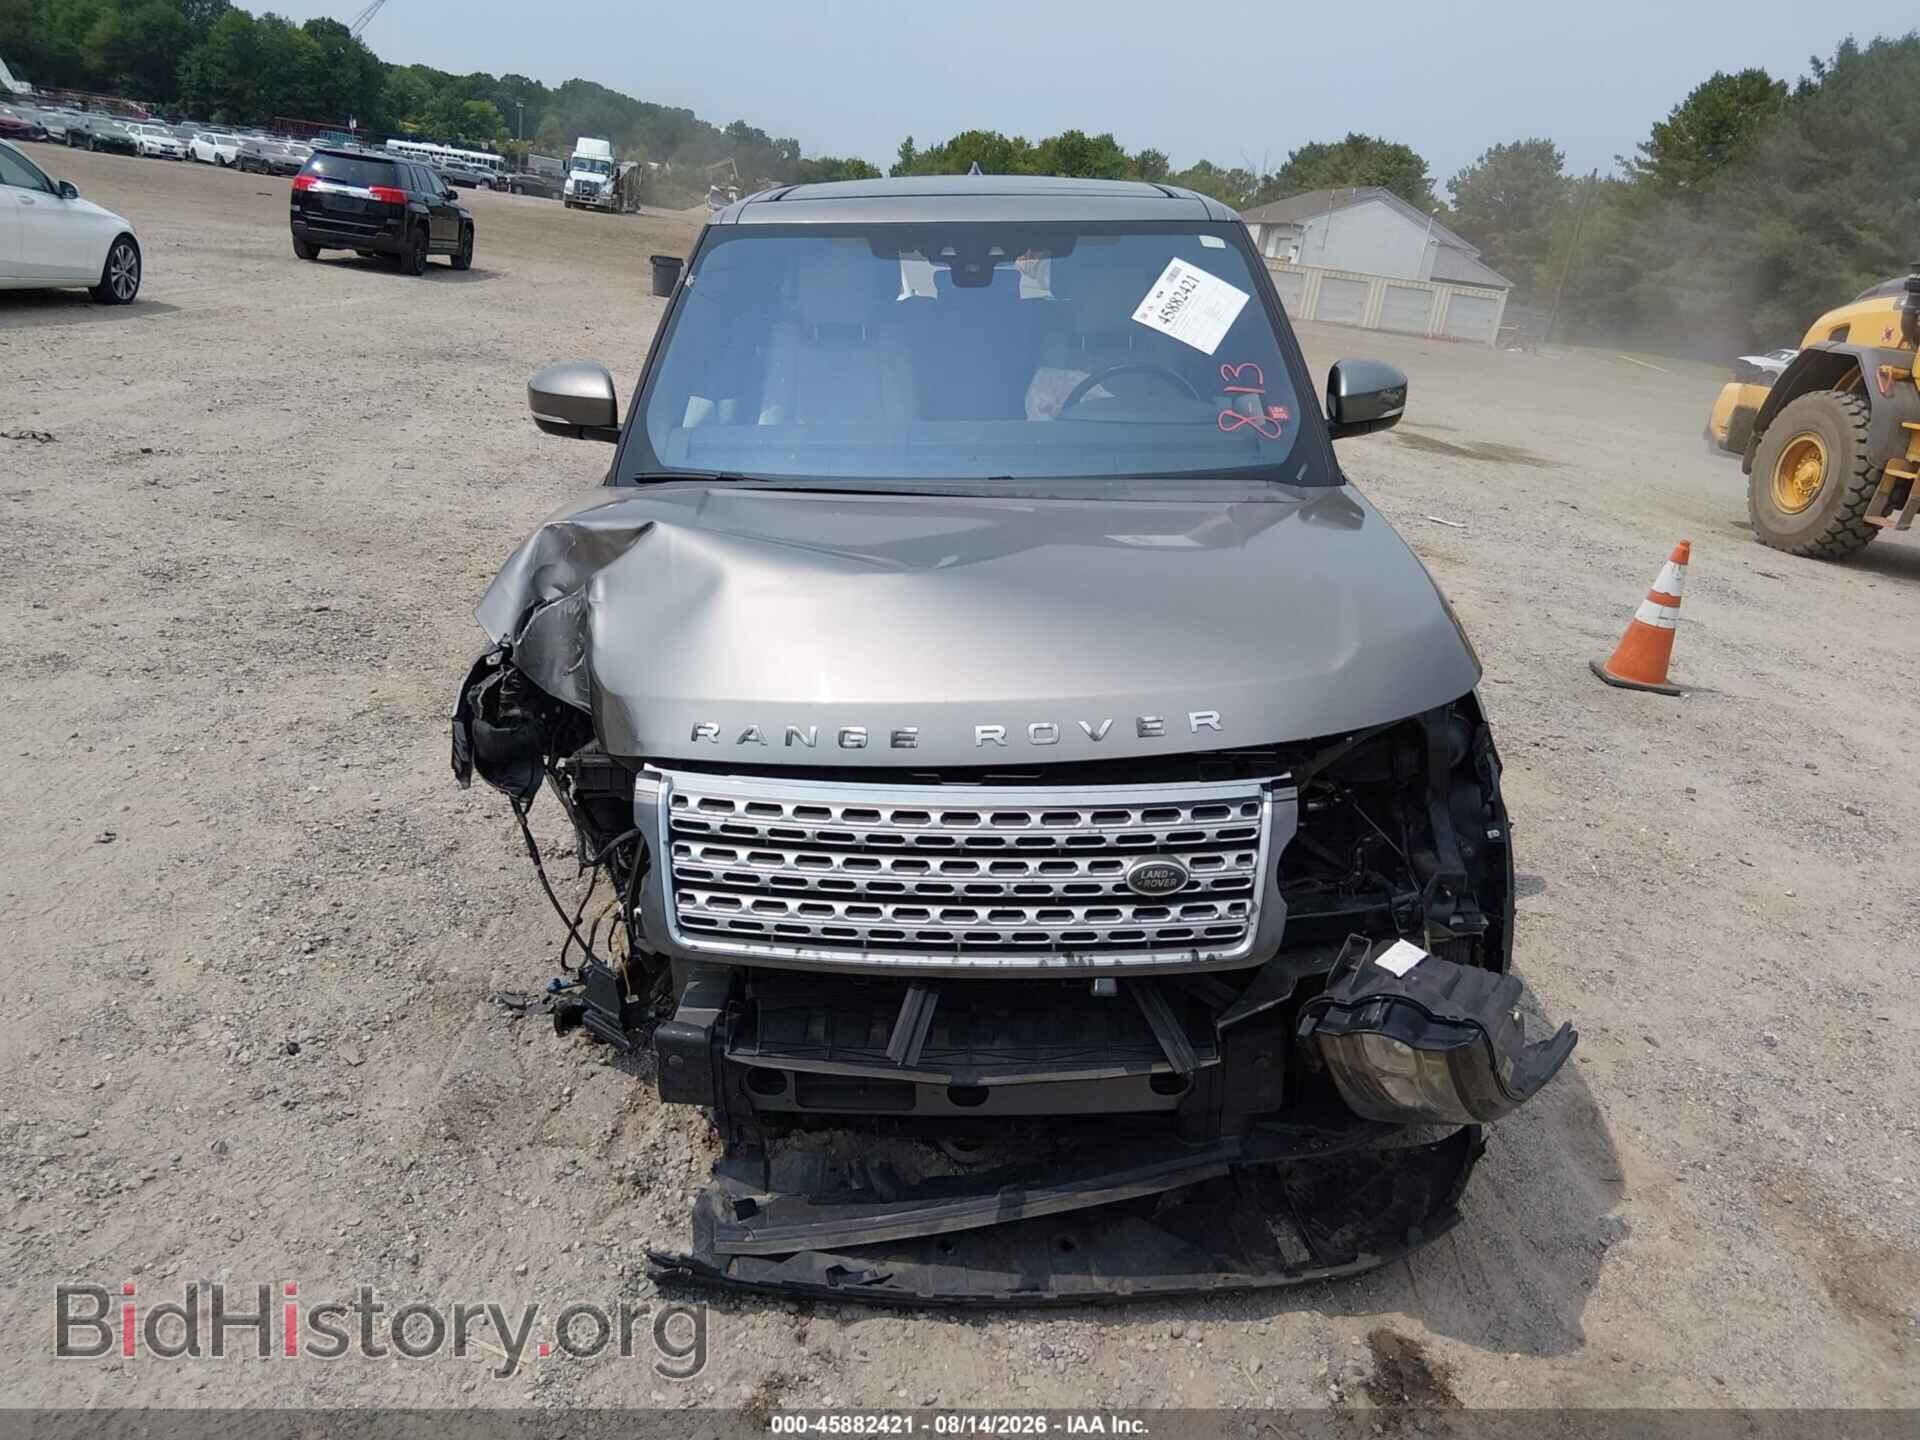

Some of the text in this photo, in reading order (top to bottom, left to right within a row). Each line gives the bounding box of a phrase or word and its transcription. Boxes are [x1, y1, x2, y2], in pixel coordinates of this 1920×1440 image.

[1157, 274, 1200, 325] 45882421
[690, 710, 1224, 749] RANGE ROVER
[1140, 870, 1168, 879] LAND
[1143, 878, 1177, 889] ROVER
